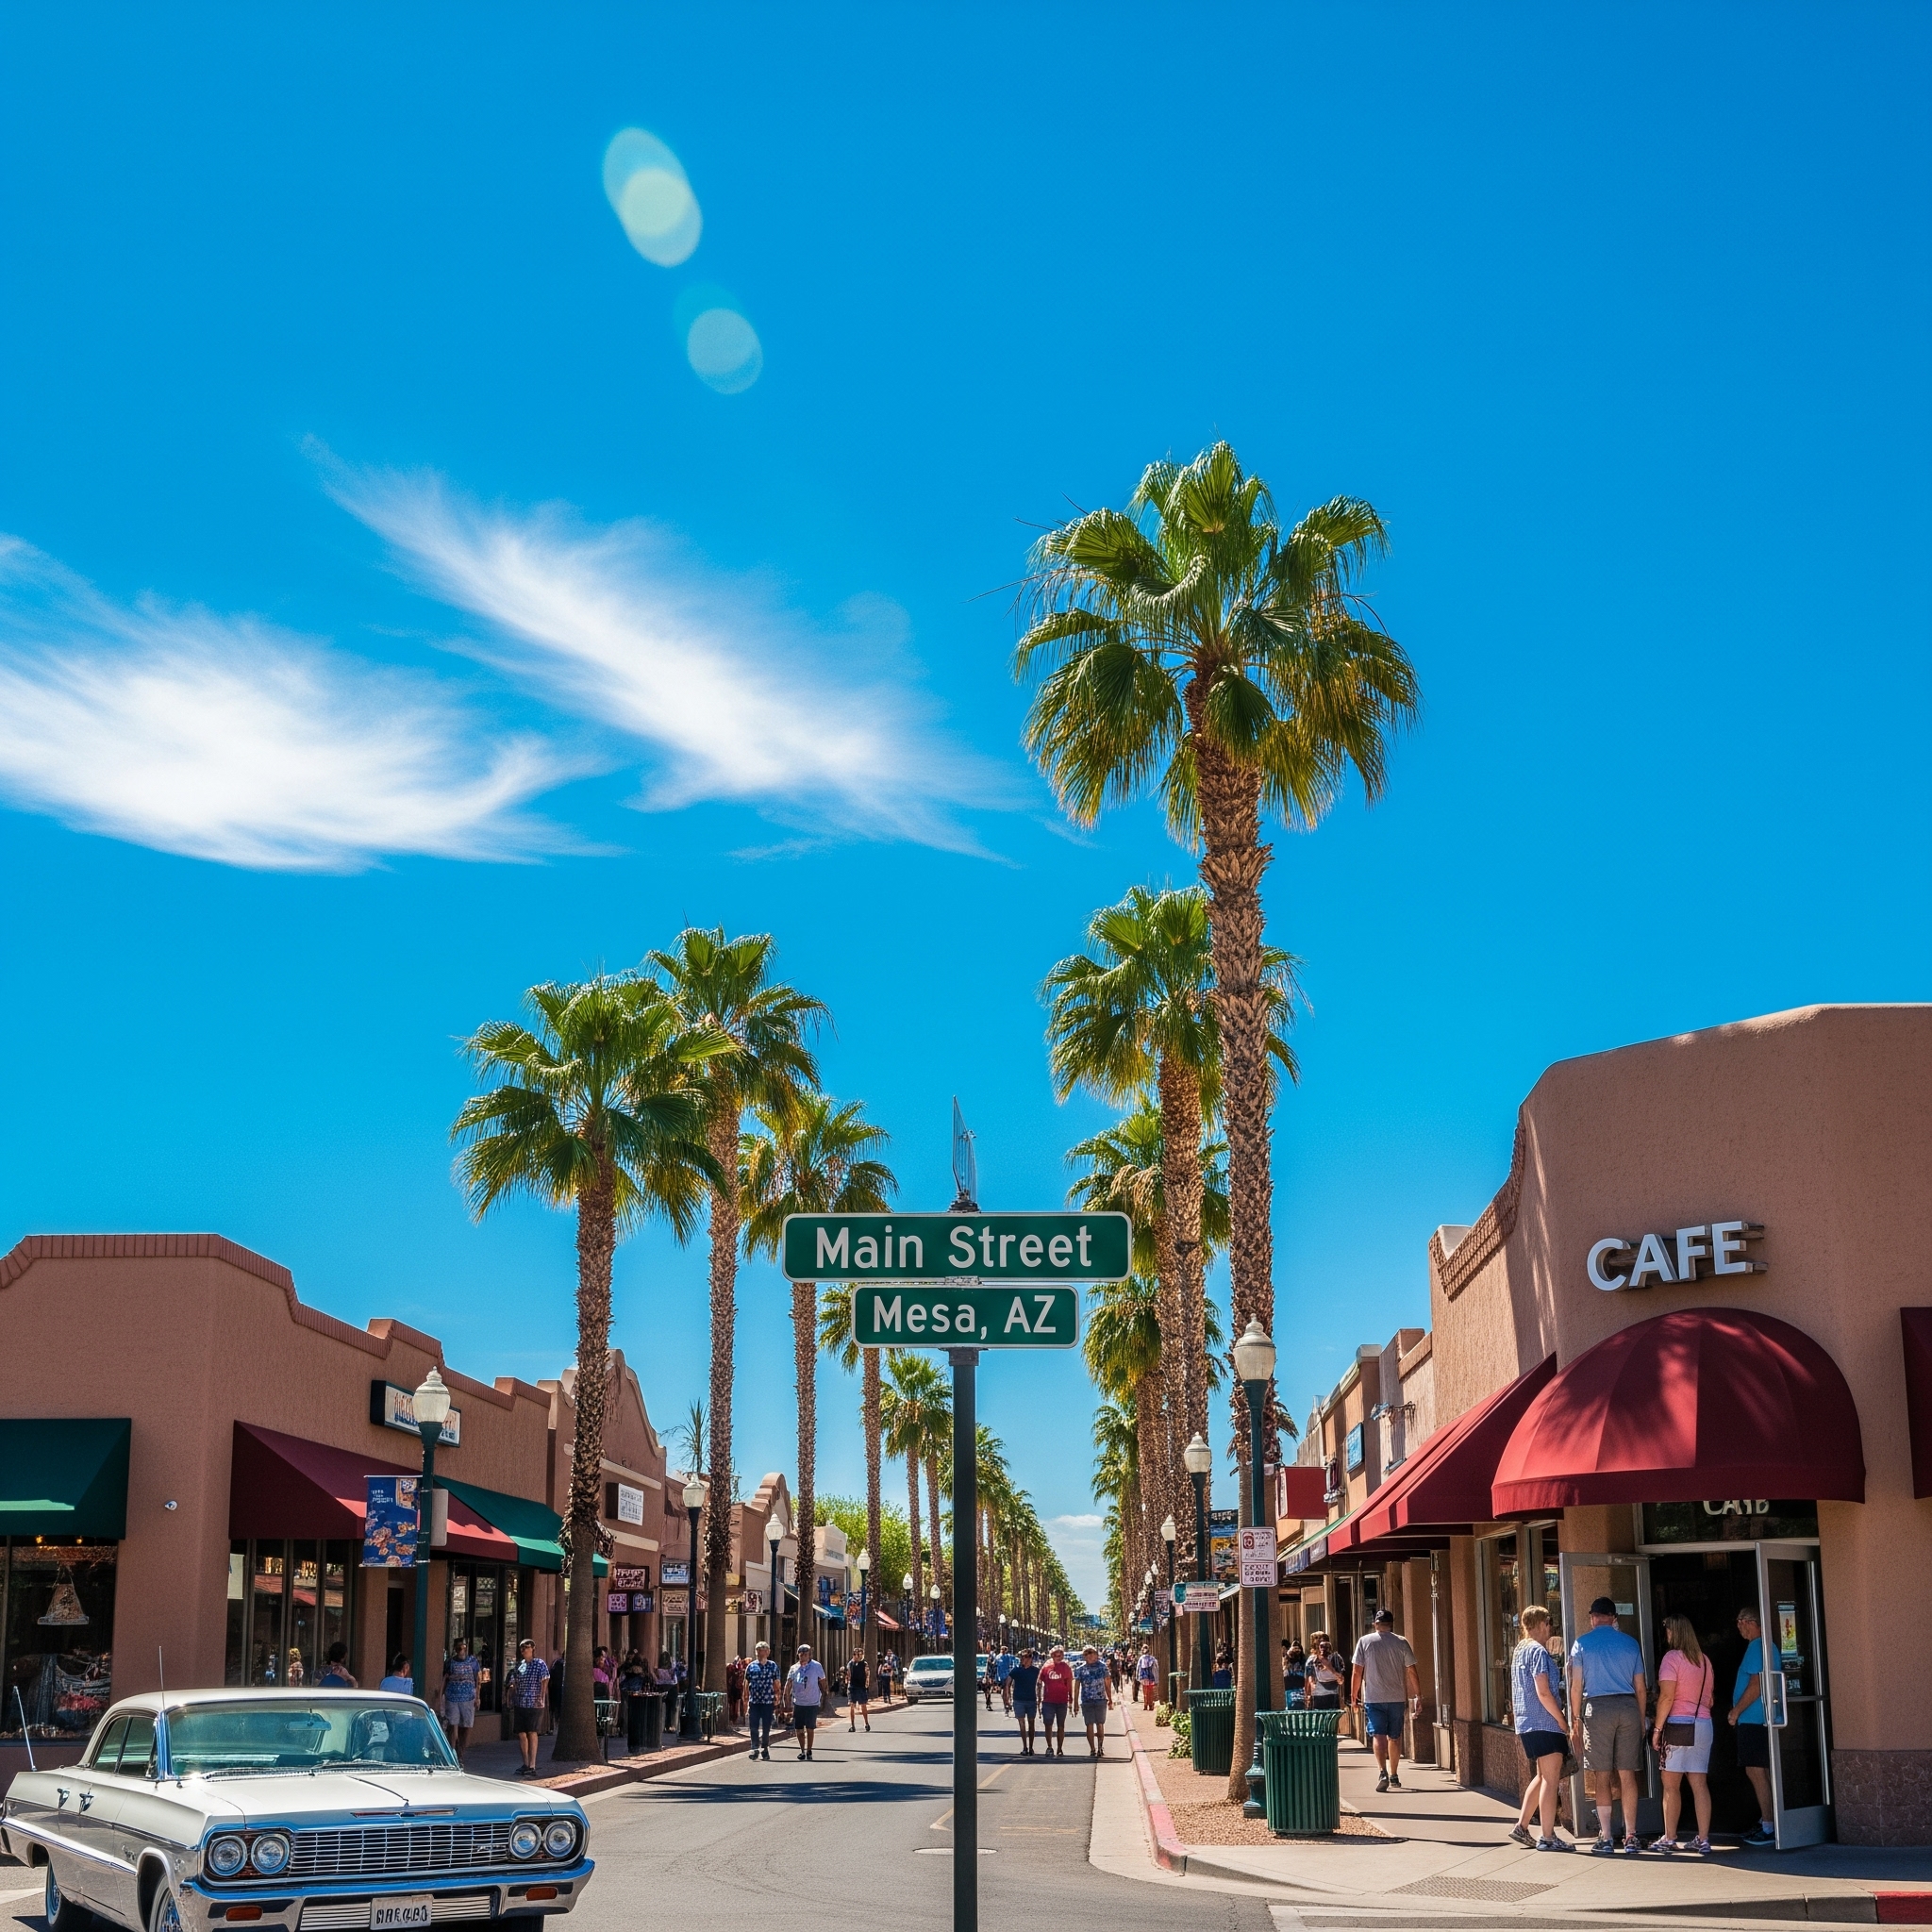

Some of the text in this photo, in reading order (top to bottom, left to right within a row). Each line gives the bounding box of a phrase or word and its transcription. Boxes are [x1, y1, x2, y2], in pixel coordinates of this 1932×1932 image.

[816, 1224, 1092, 1269] Main Street
[1587, 1221, 1747, 1291] CAFE
[873, 1295, 1057, 1341] Mesa, AZ
